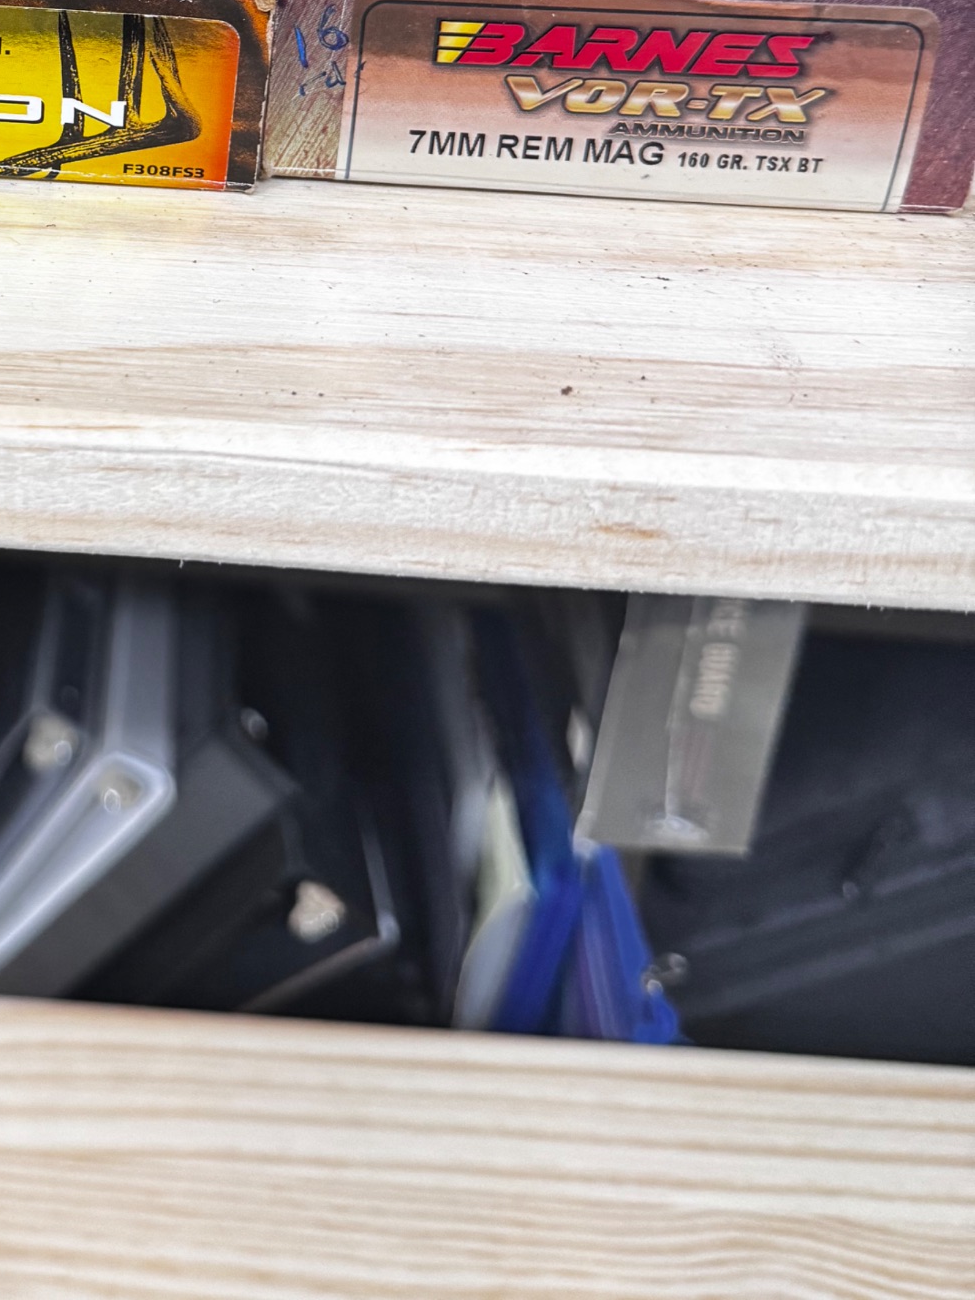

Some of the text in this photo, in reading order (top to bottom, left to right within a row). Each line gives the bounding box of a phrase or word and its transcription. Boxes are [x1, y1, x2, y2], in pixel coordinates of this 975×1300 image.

[436, 20, 815, 78] BARNES
[505, 74, 825, 123] VOR-TX
[409, 130, 824, 173] 7MM REM MAG 160 GR. TSX BT
[607, 122, 806, 143] AMMUNITION
[123, 163, 205, 178] F308FS3
